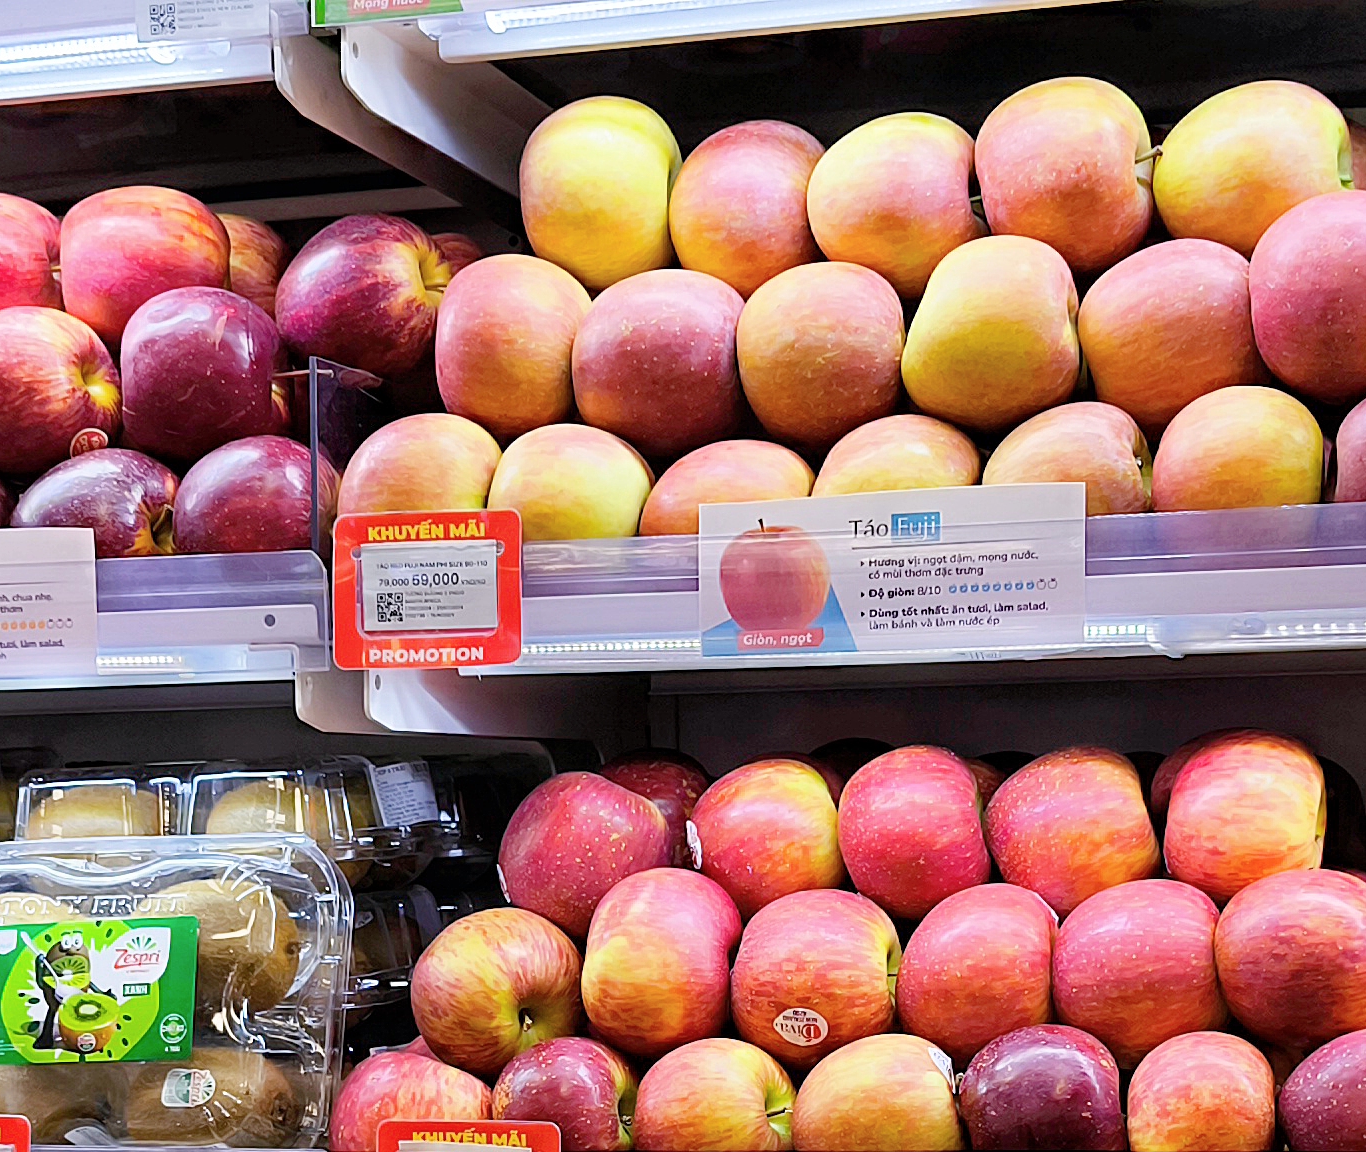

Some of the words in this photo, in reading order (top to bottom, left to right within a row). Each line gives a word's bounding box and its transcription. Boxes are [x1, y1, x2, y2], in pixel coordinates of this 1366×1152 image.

[367, 519, 444, 541] KHUYẾN
[450, 519, 485, 538] MÃI
[848, 519, 888, 538] Táo
[897, 515, 935, 541] Fuji
[923, 556, 947, 567] ngọt
[412, 572, 460, 588] 59,000
[869, 588, 885, 600] Độ
[888, 586, 915, 598] giòn:
[917, 586, 941, 597] 8/10
[869, 606, 899, 619] Dùng
[901, 606, 918, 617] tốt
[742, 632, 777, 646] Giòn,
[780, 631, 813, 646] ngọt
[369, 646, 484, 664] PROMOTION
[114, 949, 160, 969] Zespri
[412, 1128, 487, 1144] KHUYẾN
[492, 1130, 527, 1147] MÃI
